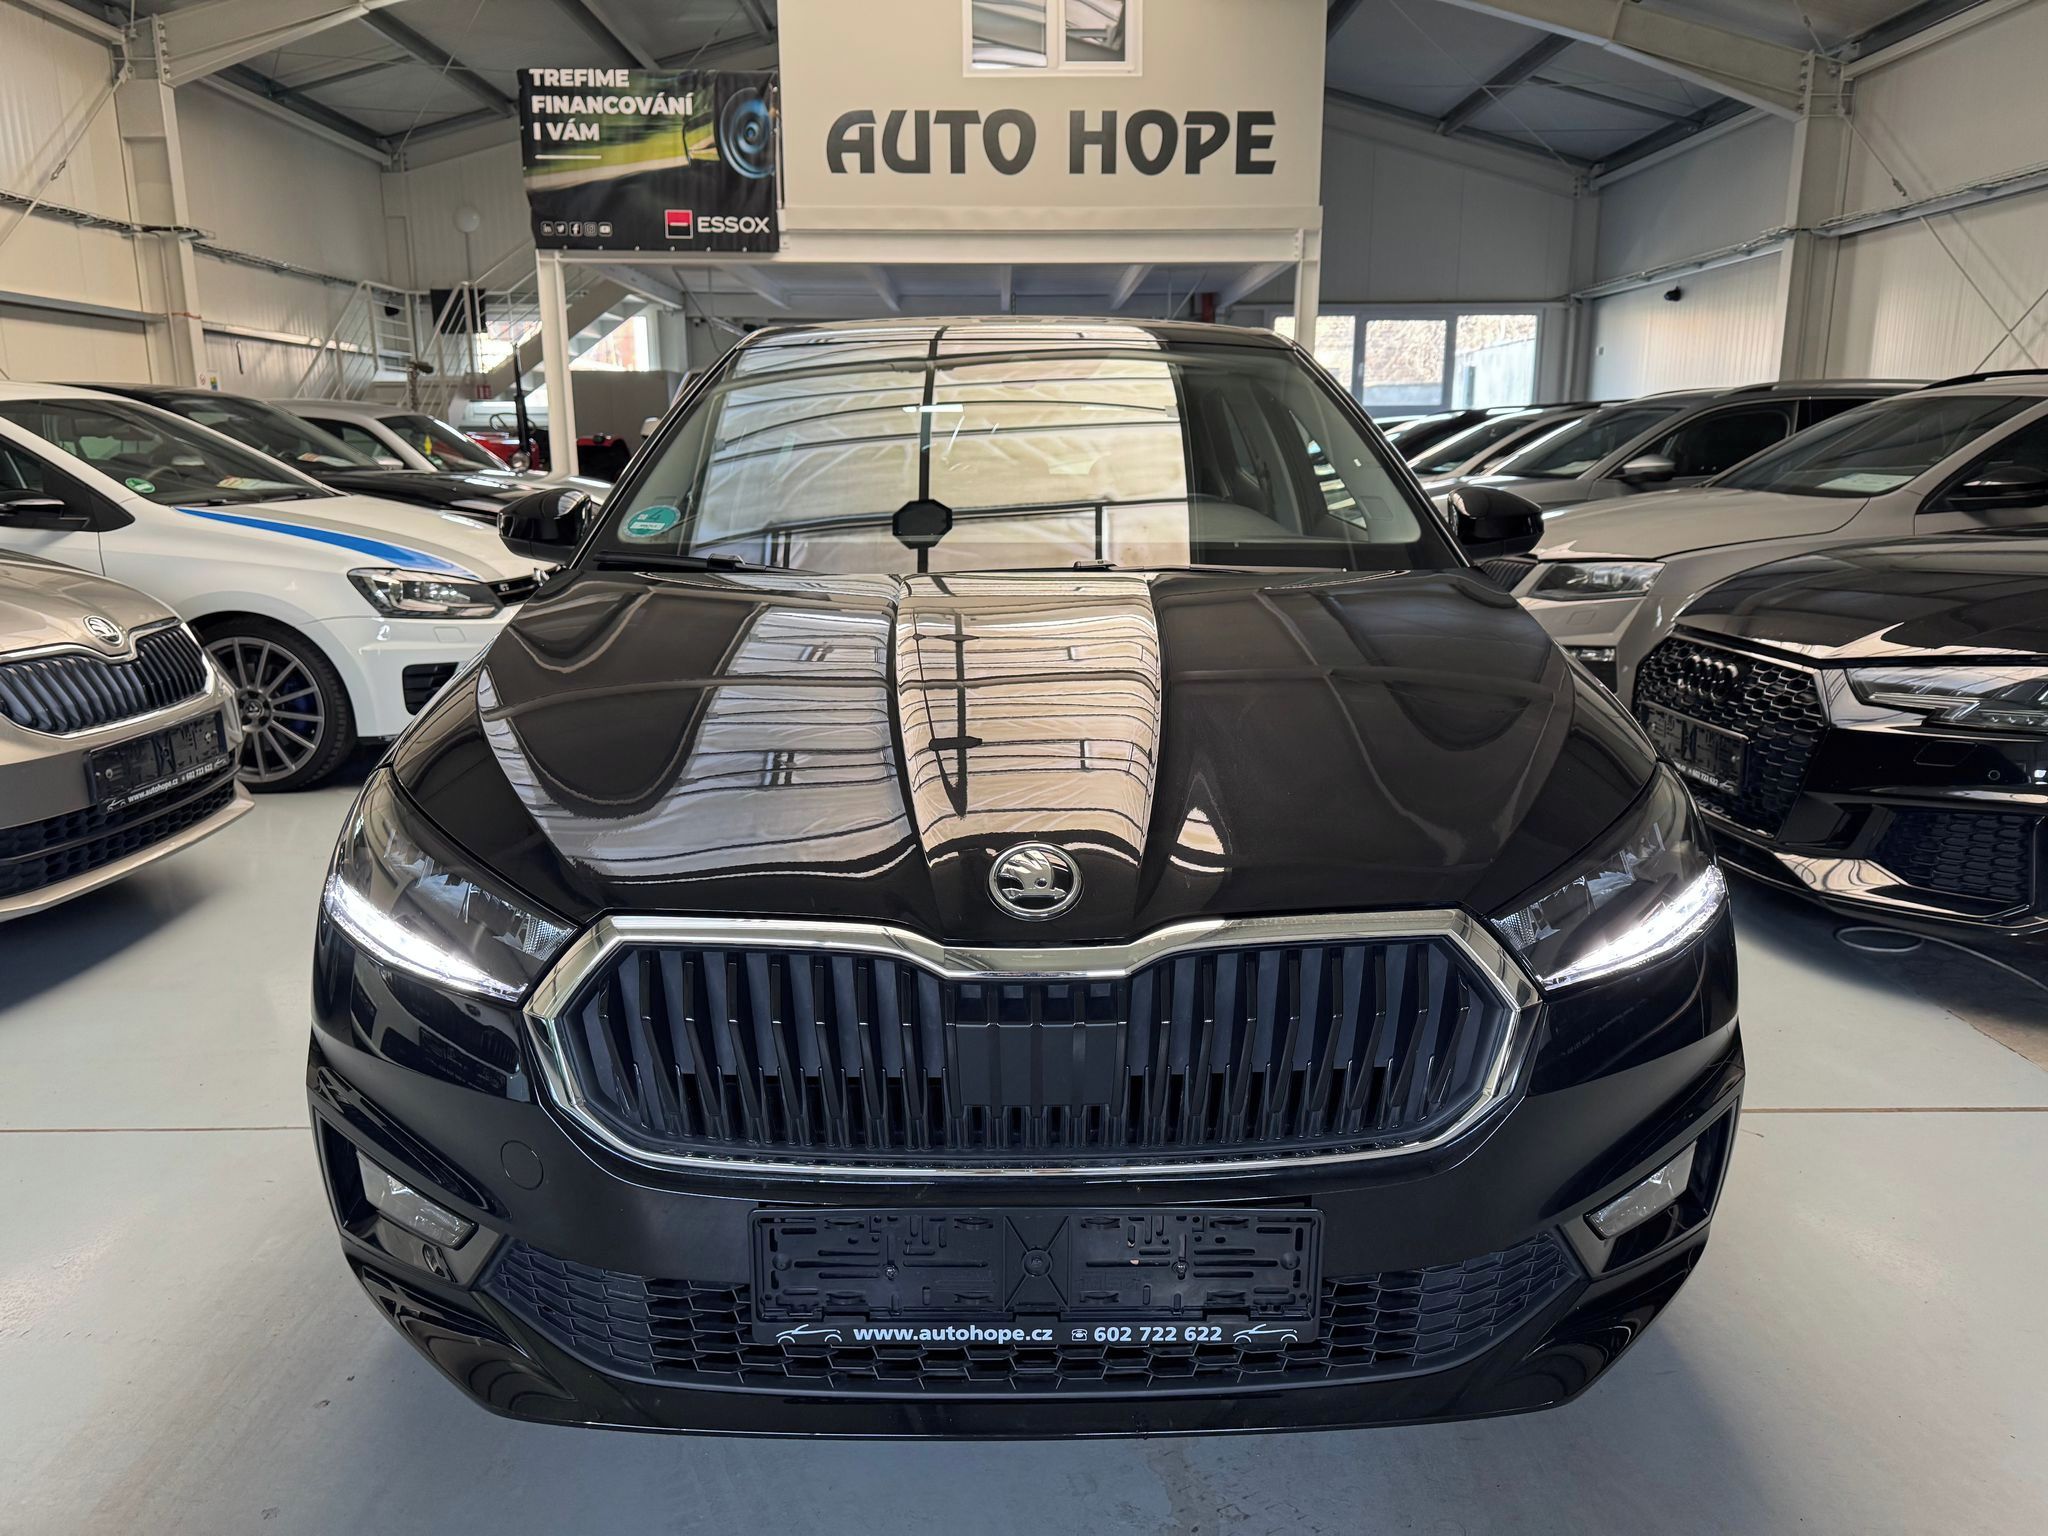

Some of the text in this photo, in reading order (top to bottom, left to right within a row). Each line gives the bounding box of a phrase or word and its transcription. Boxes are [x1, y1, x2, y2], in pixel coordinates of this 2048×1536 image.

[531, 92, 694, 115] FINANCOVÁNÍ
[533, 118, 600, 141] I VÁM
[827, 108, 1276, 175] AUTO HOPE
[697, 216, 770, 234] ESSOX
[853, 1325, 1222, 1344] www.autohope.cz 602 722 622
